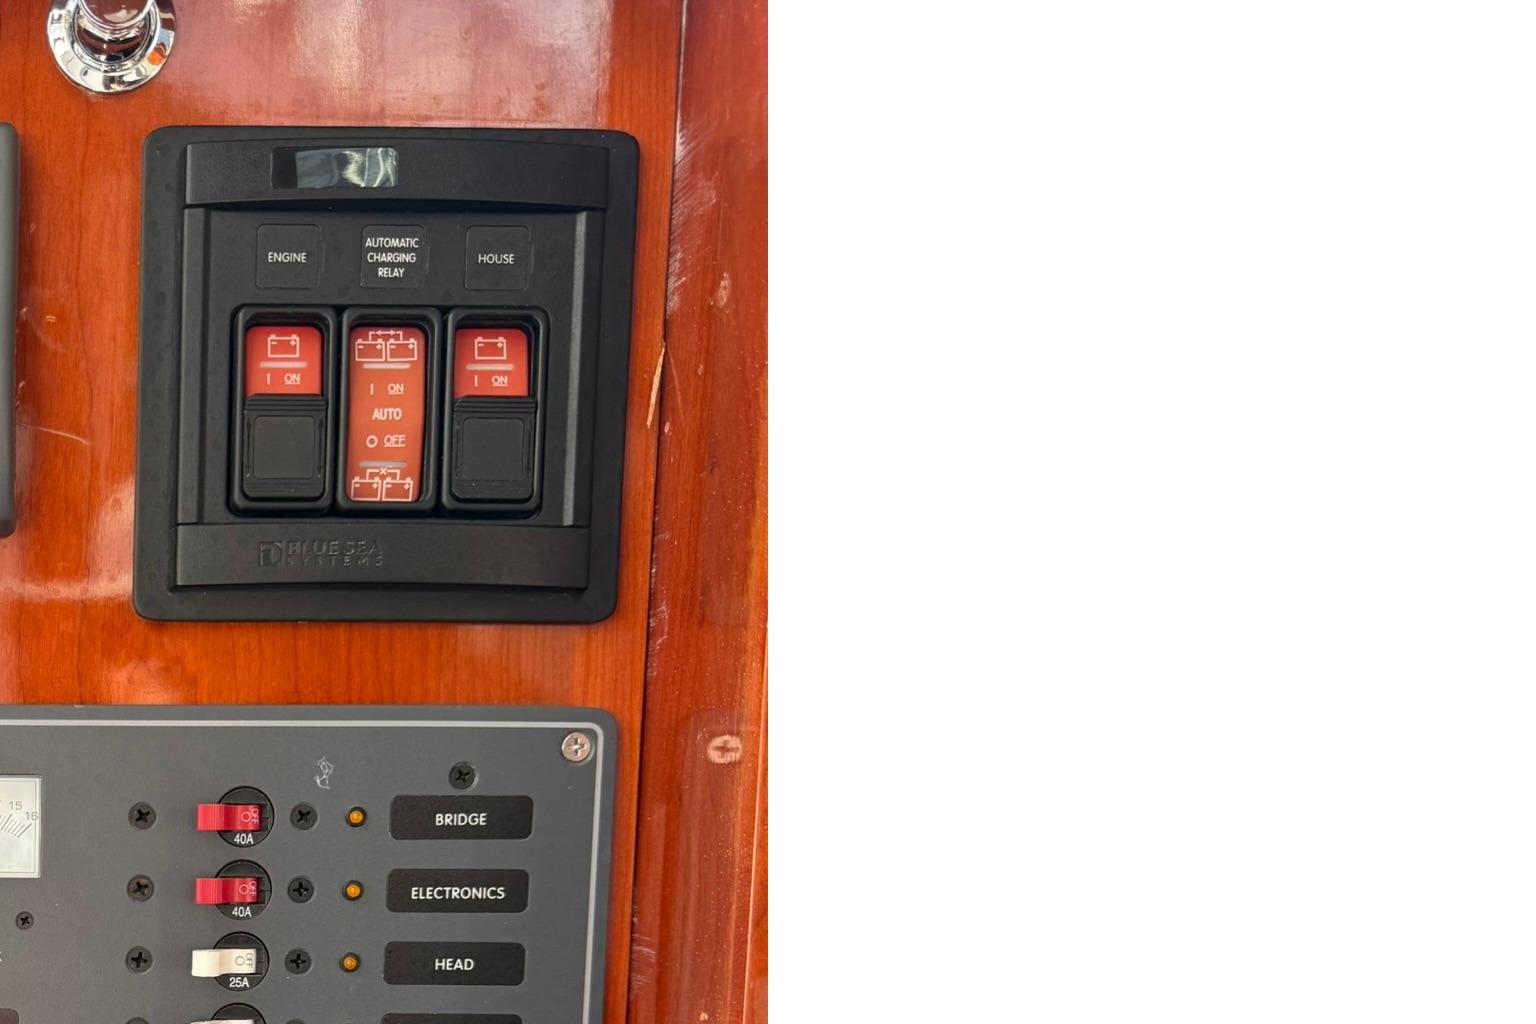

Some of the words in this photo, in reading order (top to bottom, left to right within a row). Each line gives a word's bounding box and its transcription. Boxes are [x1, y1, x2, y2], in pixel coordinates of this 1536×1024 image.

[365, 237, 419, 249] AUTOMATIC
[267, 252, 307, 264] ENGINE
[367, 252, 416, 264] CHARGING
[478, 253, 515, 265] HOUSE
[377, 267, 405, 278] RELAY
[284, 373, 301, 385] ON
[492, 375, 508, 386] ON
[388, 383, 404, 394] ON
[372, 408, 402, 421] AUTO
[384, 434, 406, 446] OFF
[288, 540, 339, 555] BLUE
[9, 801, 22, 810] 15
[25, 812, 38, 821] 16
[435, 813, 487, 826] BRIDGE
[234, 834, 254, 845] 40A
[411, 887, 506, 900] ELECTRONICS
[231, 906, 252, 918] 40A
[435, 958, 475, 970] HEAD
[229, 977, 249, 988] 25A
